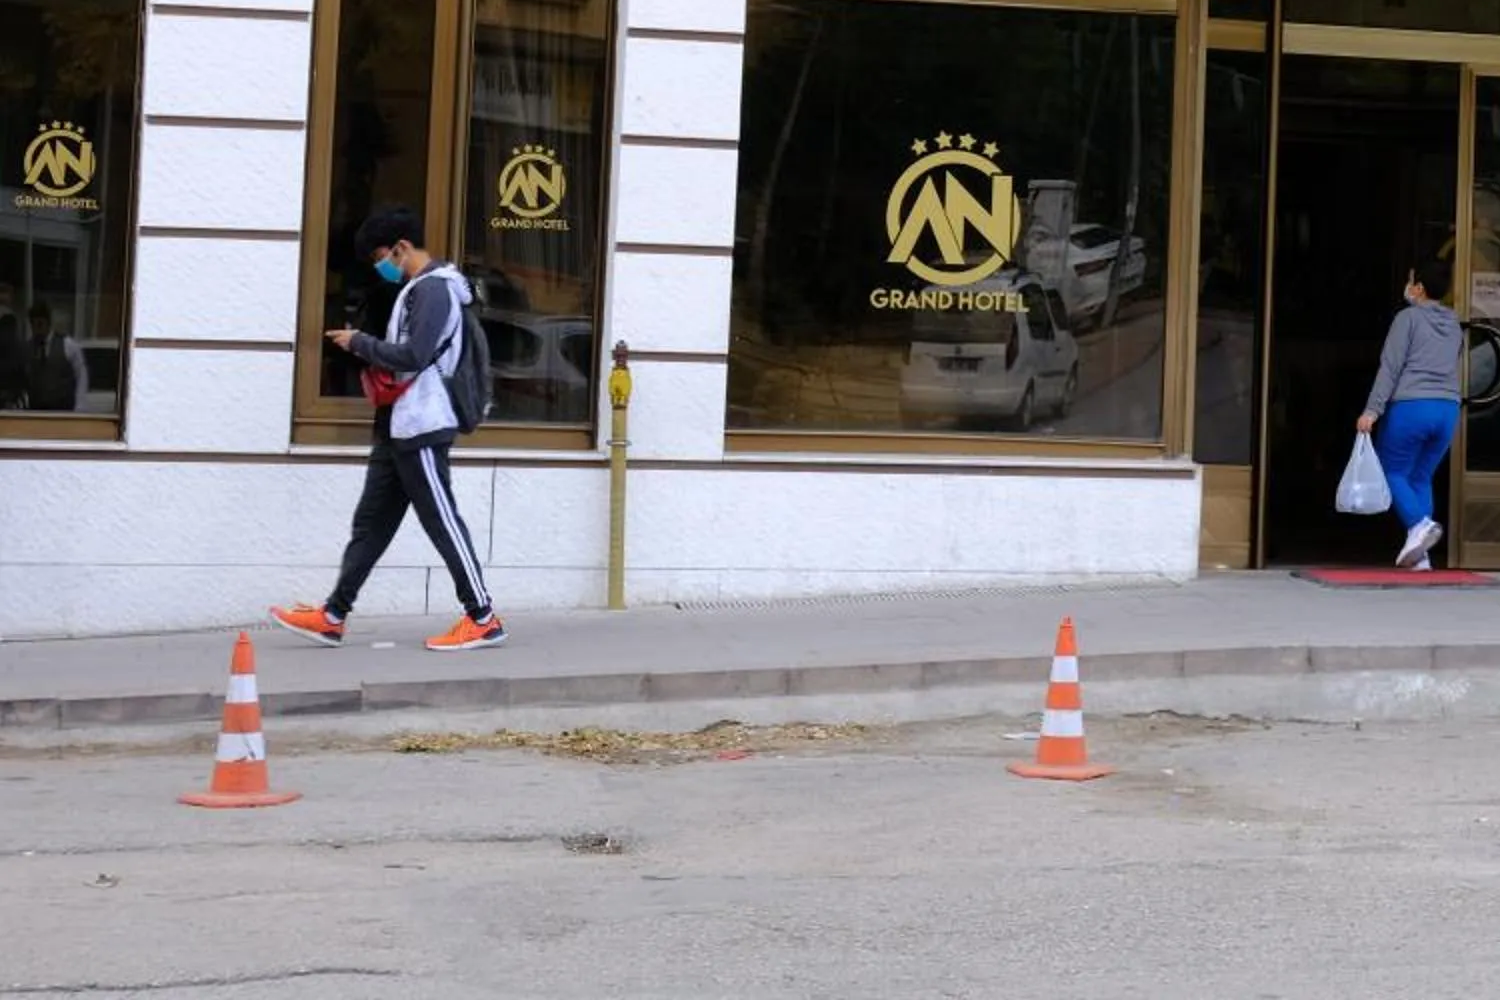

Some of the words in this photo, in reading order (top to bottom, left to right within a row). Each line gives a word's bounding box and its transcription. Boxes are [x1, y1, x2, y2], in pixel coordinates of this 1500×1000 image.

[15, 195, 59, 208] GRAND
[61, 198, 99, 211] HOTEL
[491, 217, 533, 229] GRAND
[534, 219, 571, 231] HOTEL
[868, 287, 954, 310] GRAND
[957, 290, 1031, 313] HOTEL
